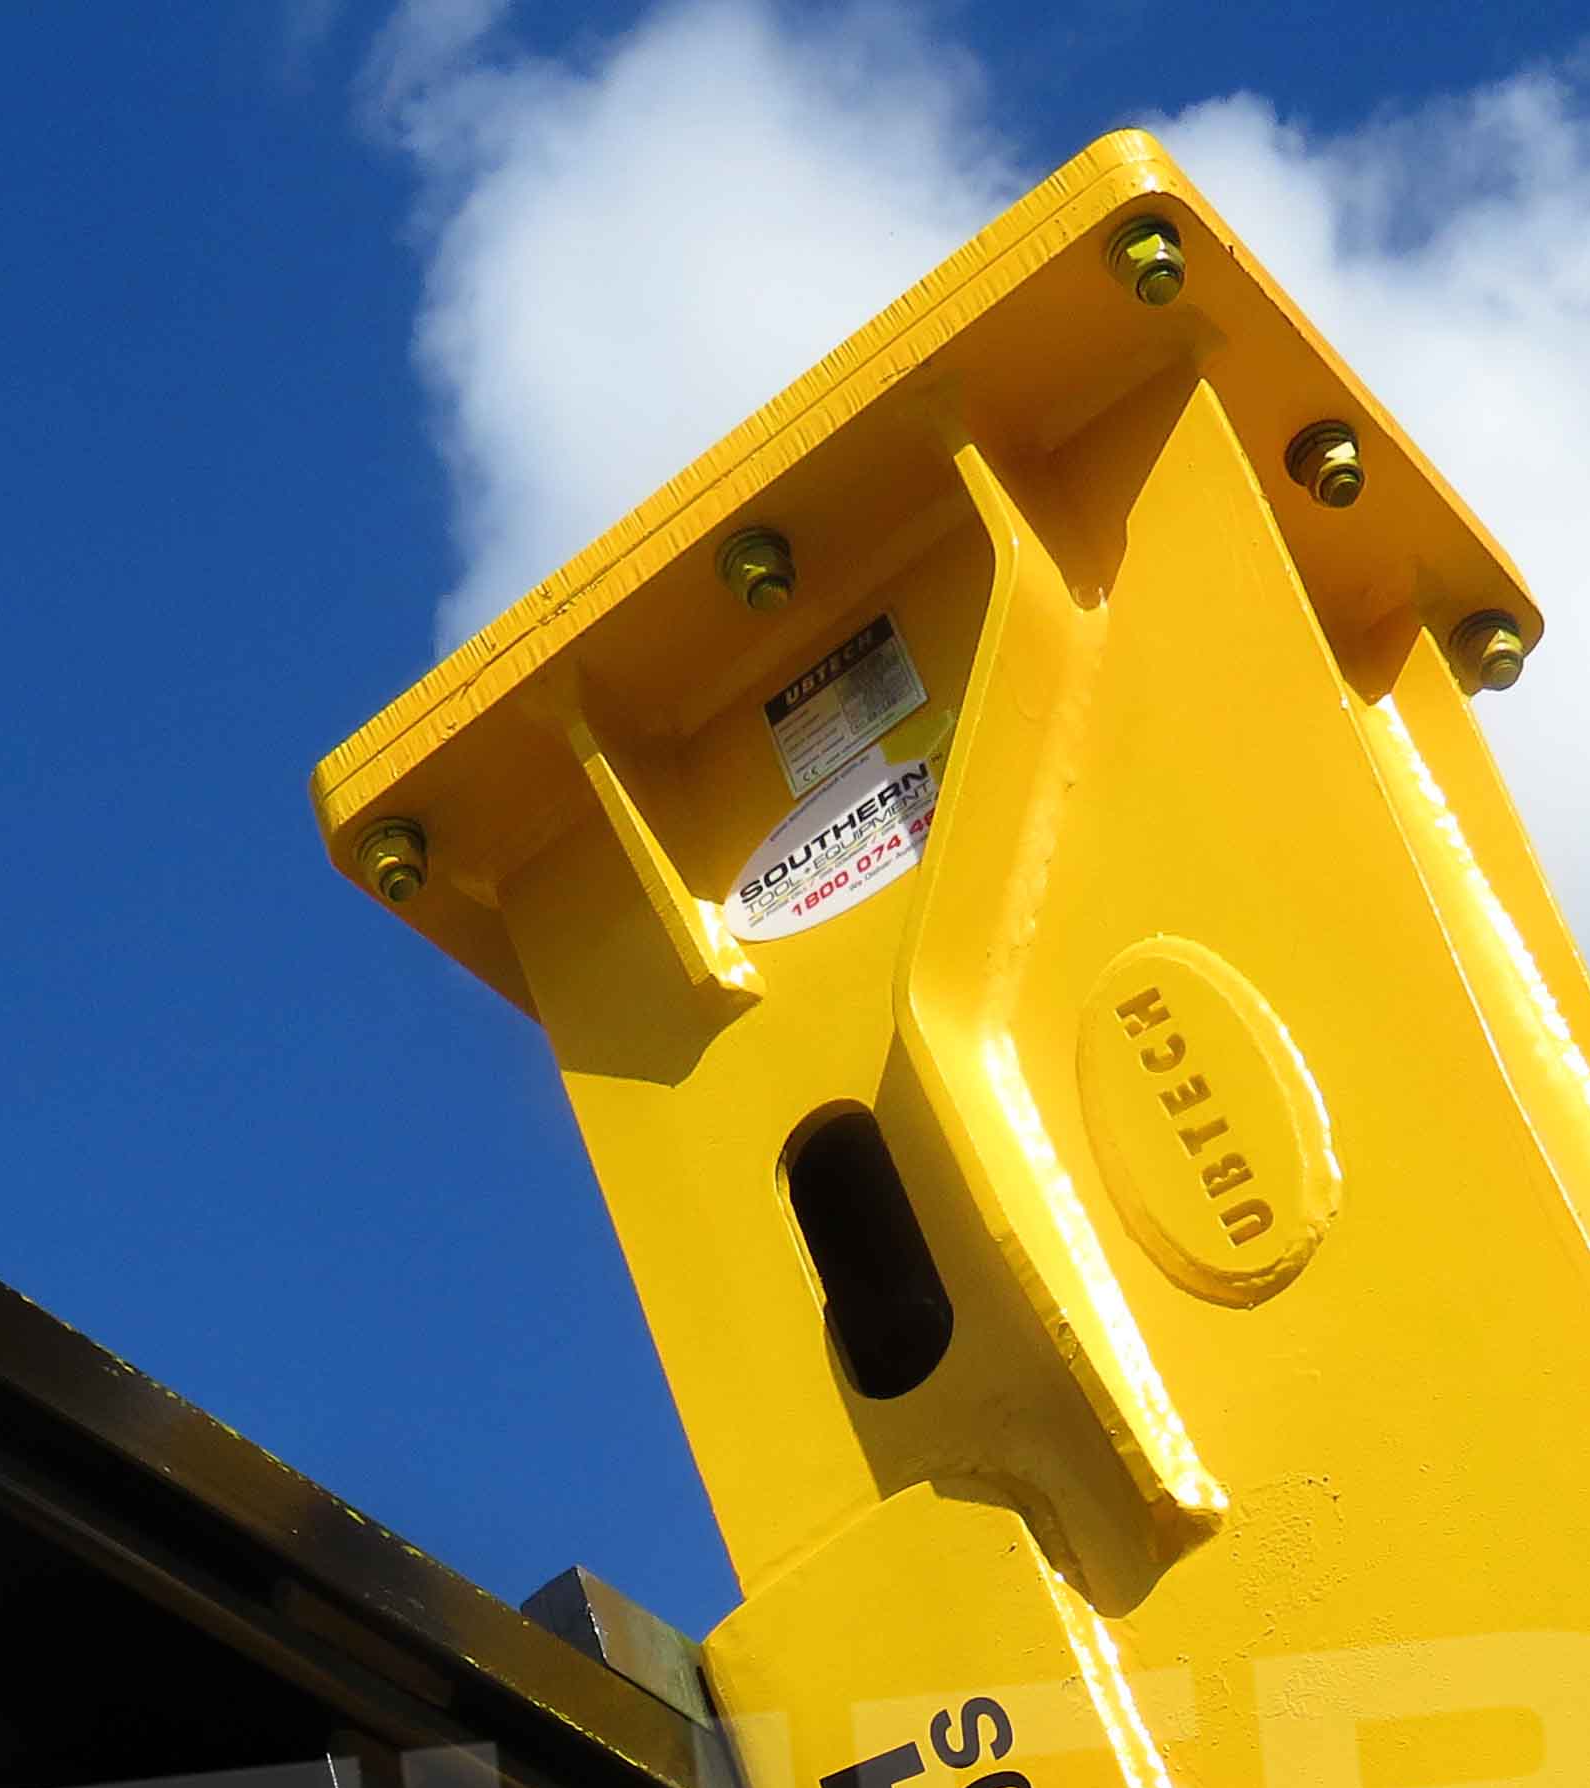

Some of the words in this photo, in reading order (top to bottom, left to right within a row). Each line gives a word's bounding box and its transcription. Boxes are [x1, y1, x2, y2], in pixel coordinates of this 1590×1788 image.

[739, 763, 929, 904] SOUTHERN
[747, 878, 802, 915] TOOL
[813, 779, 930, 869] EQUIPMENT
[791, 871, 850, 916] 1800
[856, 834, 902, 873] 074
[1115, 986, 1274, 1247] UBTECH
